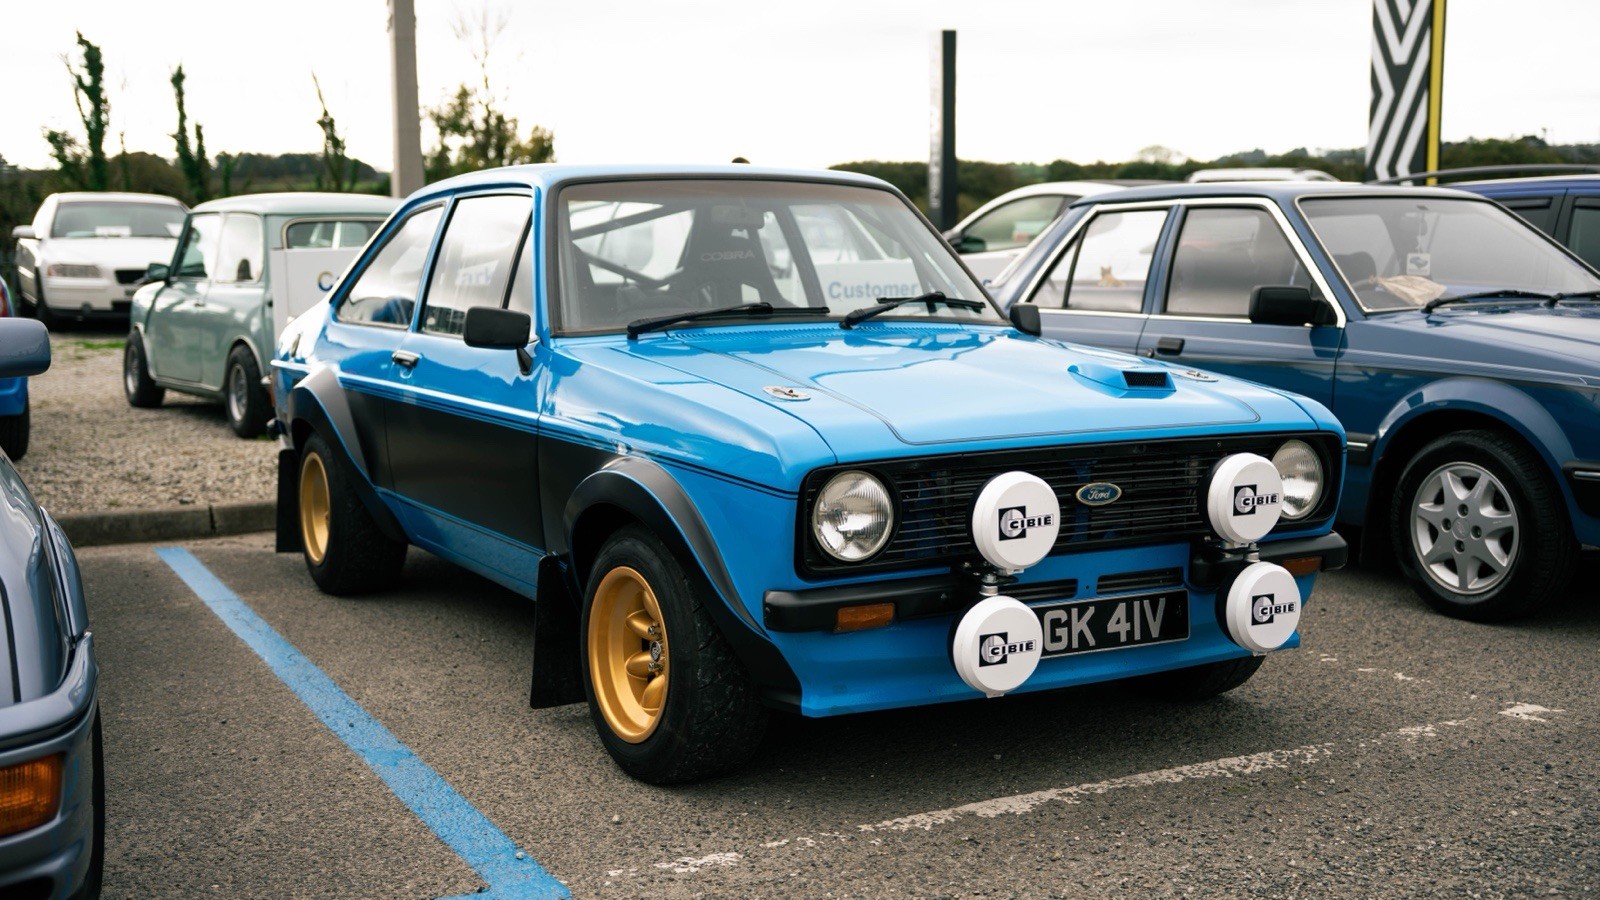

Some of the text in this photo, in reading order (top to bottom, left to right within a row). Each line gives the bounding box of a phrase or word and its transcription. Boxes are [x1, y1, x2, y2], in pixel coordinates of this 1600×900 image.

[701, 249, 756, 261] COBRA
[828, 280, 919, 299] Customer
[1087, 487, 1112, 500] Ford
[1242, 493, 1278, 506] CIBIE
[1009, 515, 1053, 530] CIBIE
[1260, 603, 1295, 615] CIBIE
[1107, 597, 1166, 643] 41V
[990, 641, 1034, 656] CIBIE
